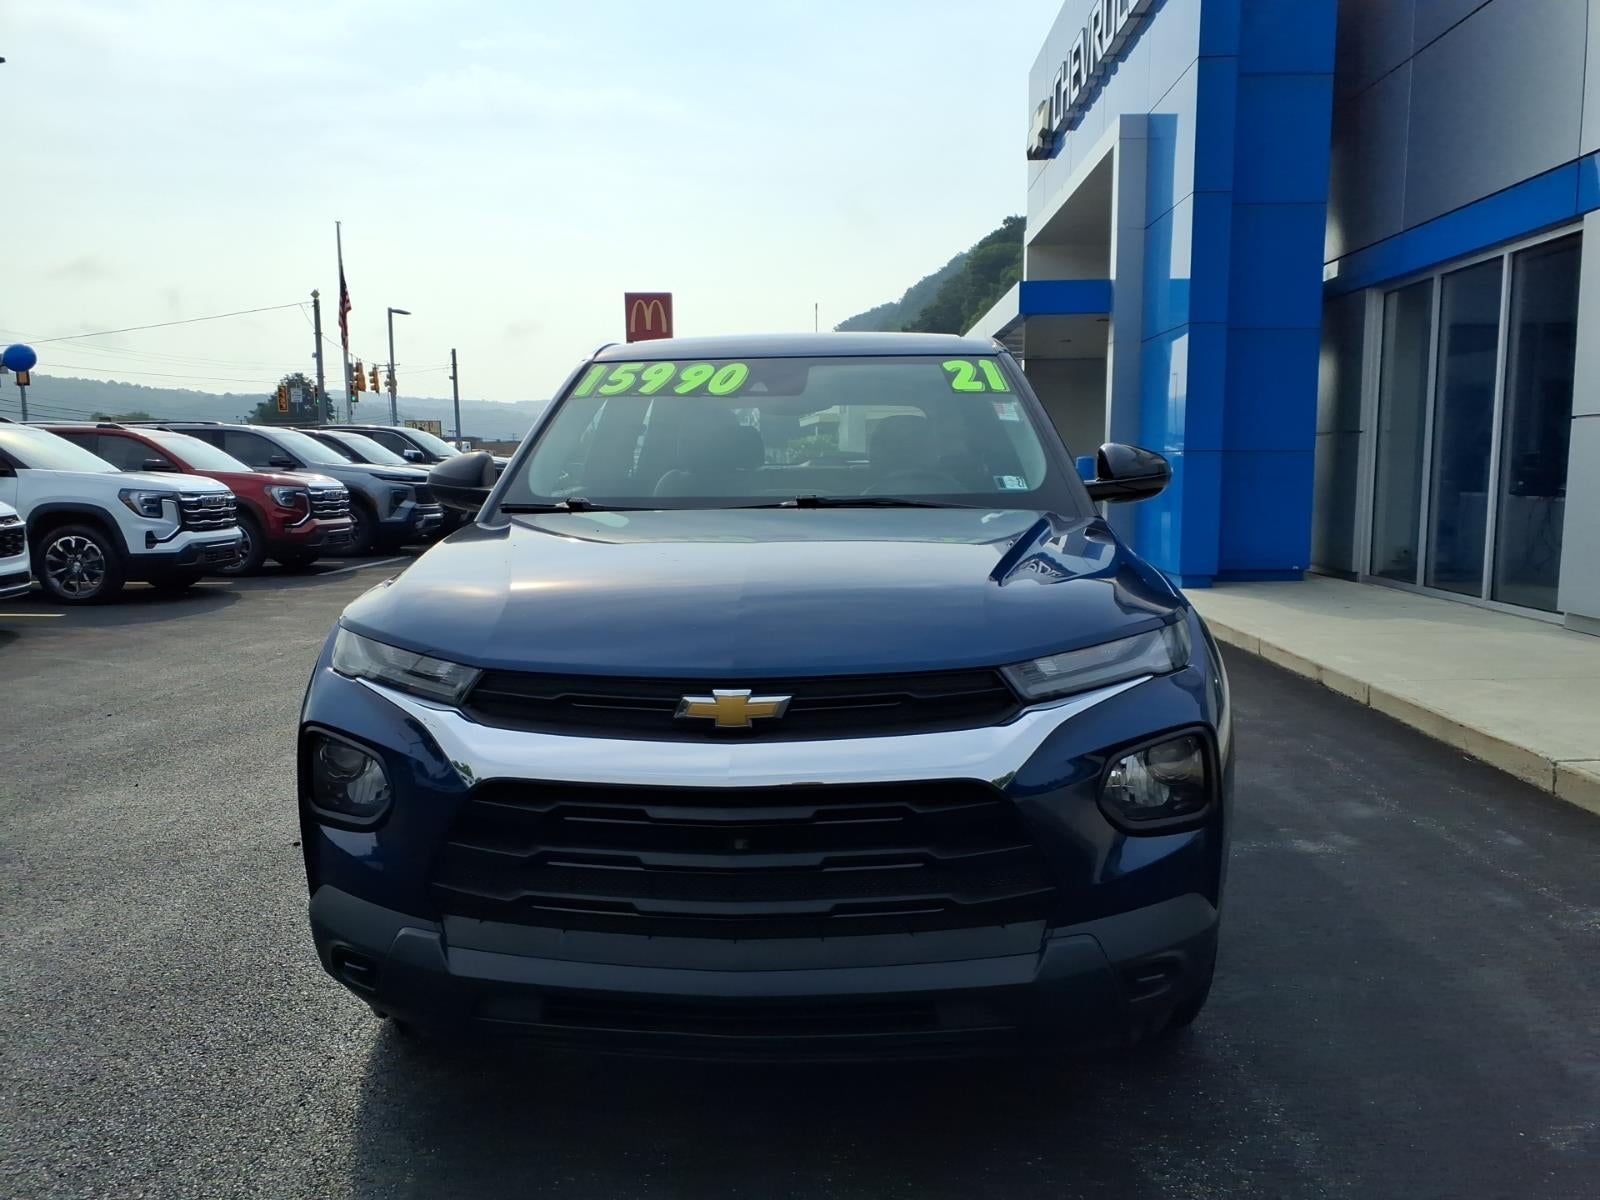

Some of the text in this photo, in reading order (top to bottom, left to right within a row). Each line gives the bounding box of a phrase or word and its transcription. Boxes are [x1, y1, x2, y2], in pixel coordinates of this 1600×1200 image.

[1052, 0, 1140, 132] CHEVROL
[573, 362, 749, 396] 15990
[942, 359, 1011, 392] 21
